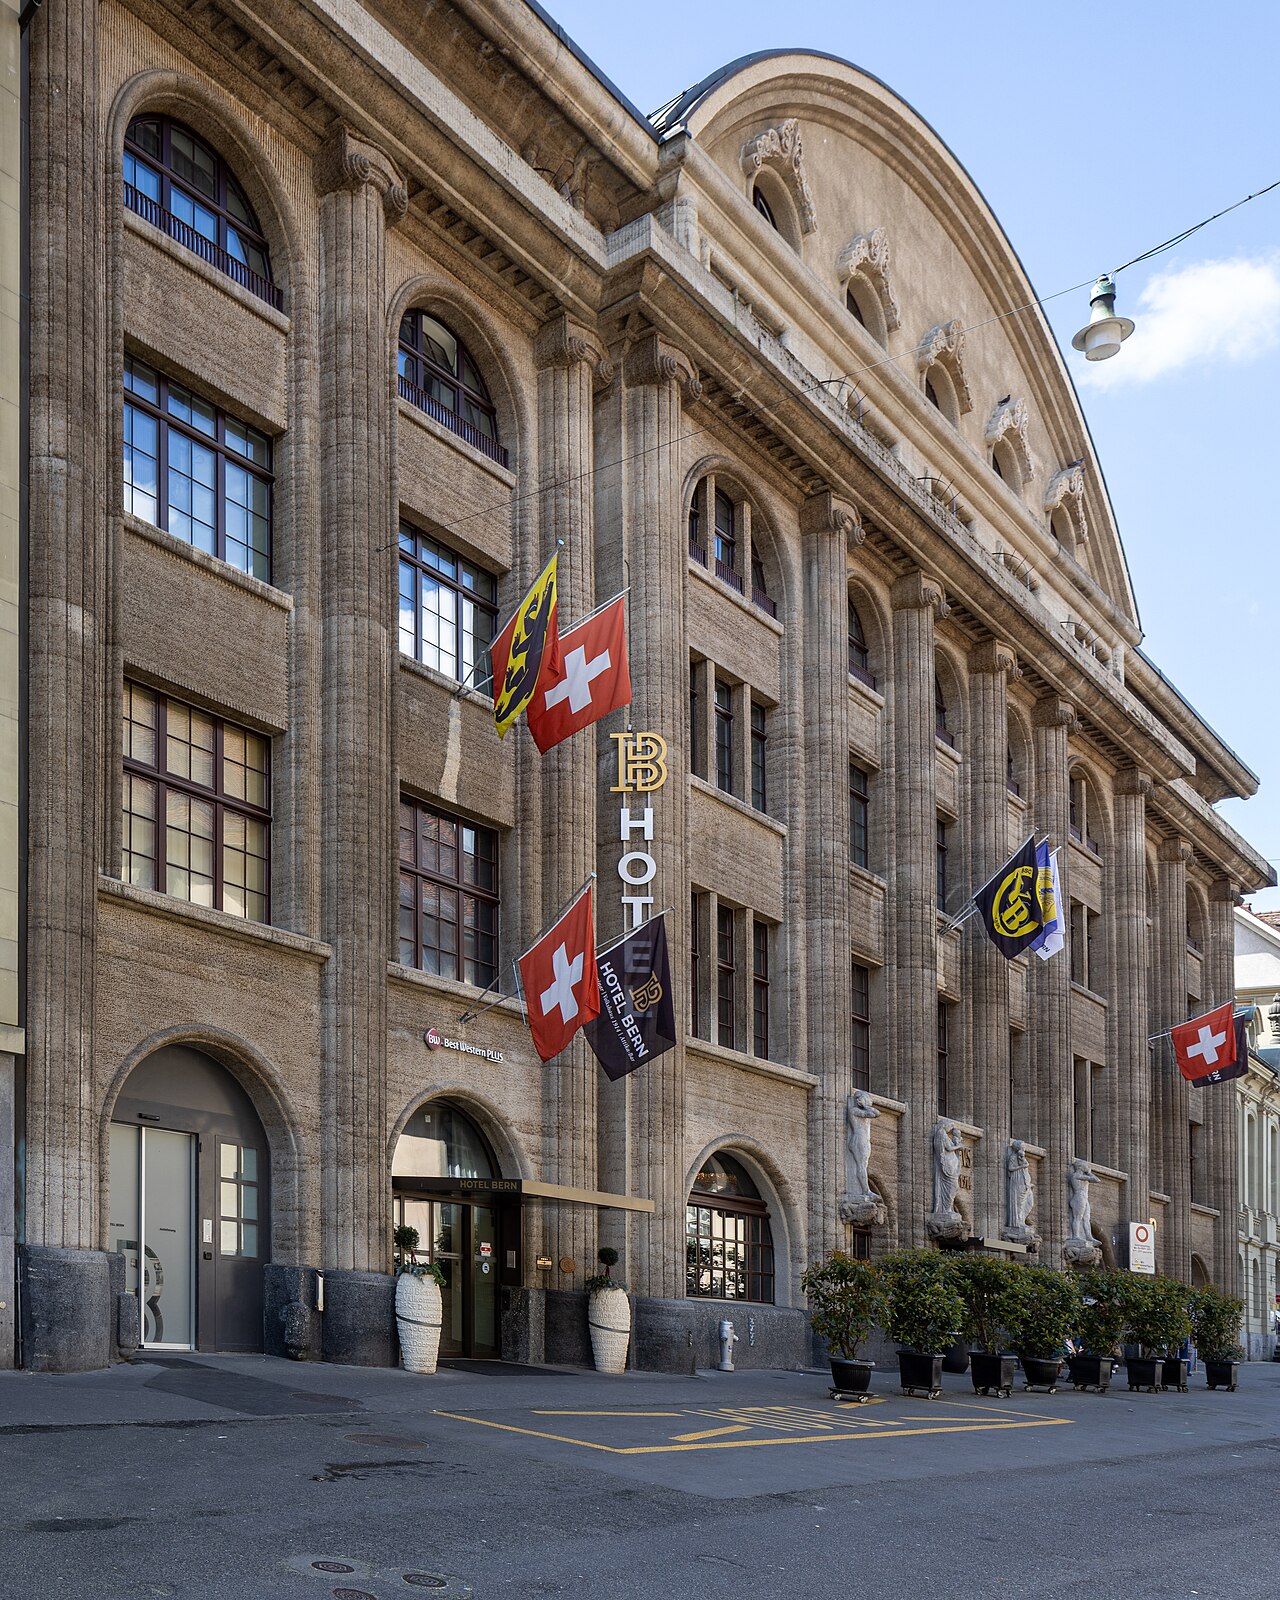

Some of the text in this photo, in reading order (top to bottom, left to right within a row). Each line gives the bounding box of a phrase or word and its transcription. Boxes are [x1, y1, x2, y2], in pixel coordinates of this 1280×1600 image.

[600, 961, 649, 1058] HOTEL BERN
[428, 1034, 504, 1061] BW Best Western PLUS
[460, 1180, 518, 1190] HOTEL BERN
